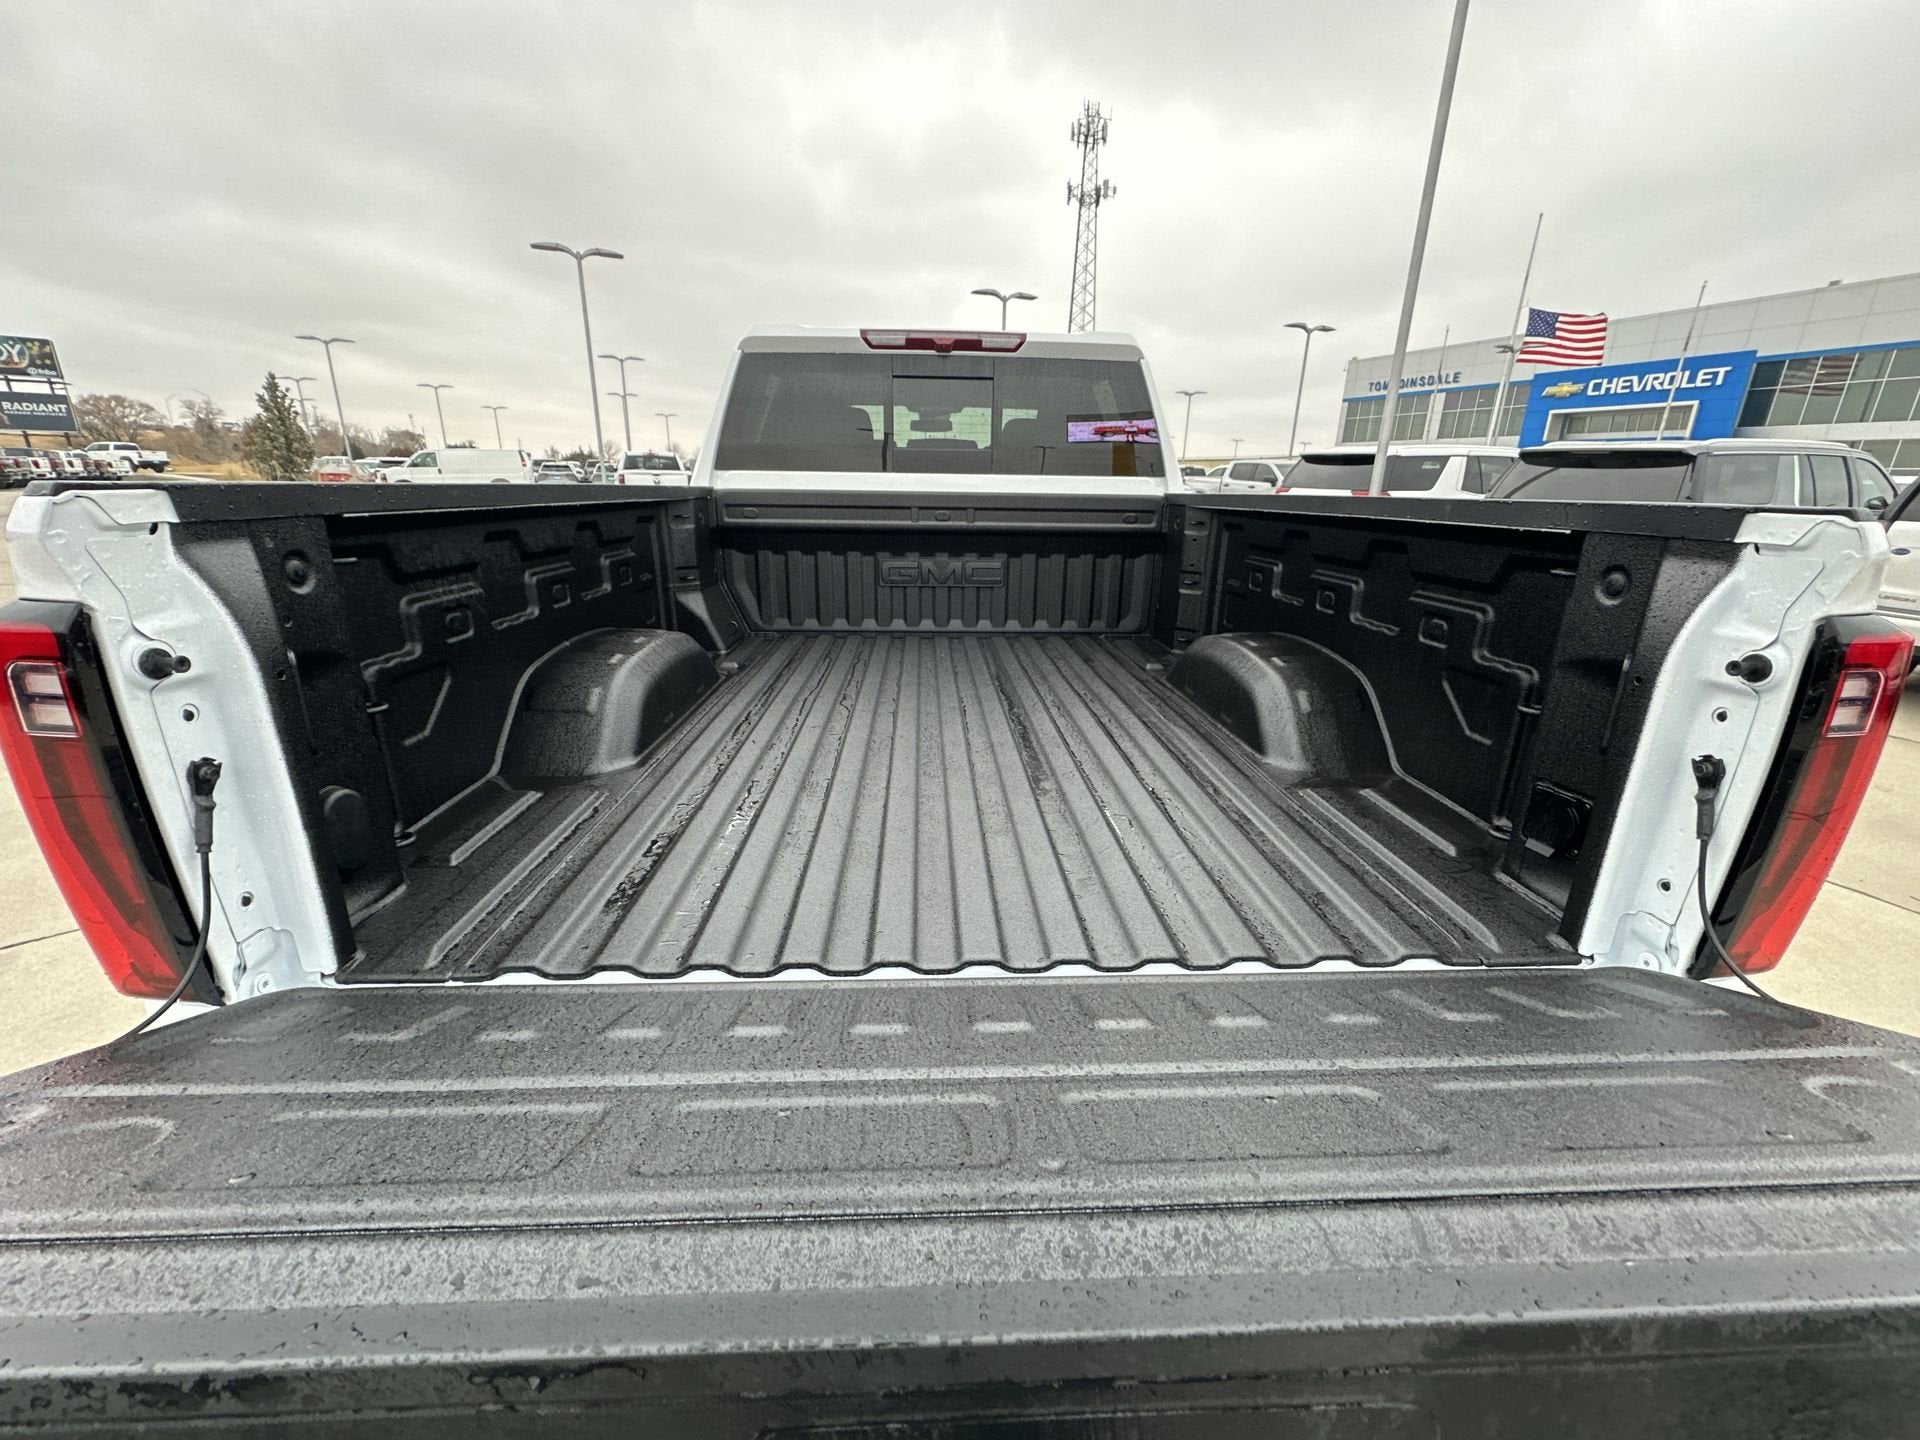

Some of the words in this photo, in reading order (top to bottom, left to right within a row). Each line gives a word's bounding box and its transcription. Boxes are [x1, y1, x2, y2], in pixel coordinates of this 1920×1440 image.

[1586, 366, 1733, 396] CHEVROLET
[1, 401, 68, 413] RADIANT
[881, 561, 1001, 585] GMC
